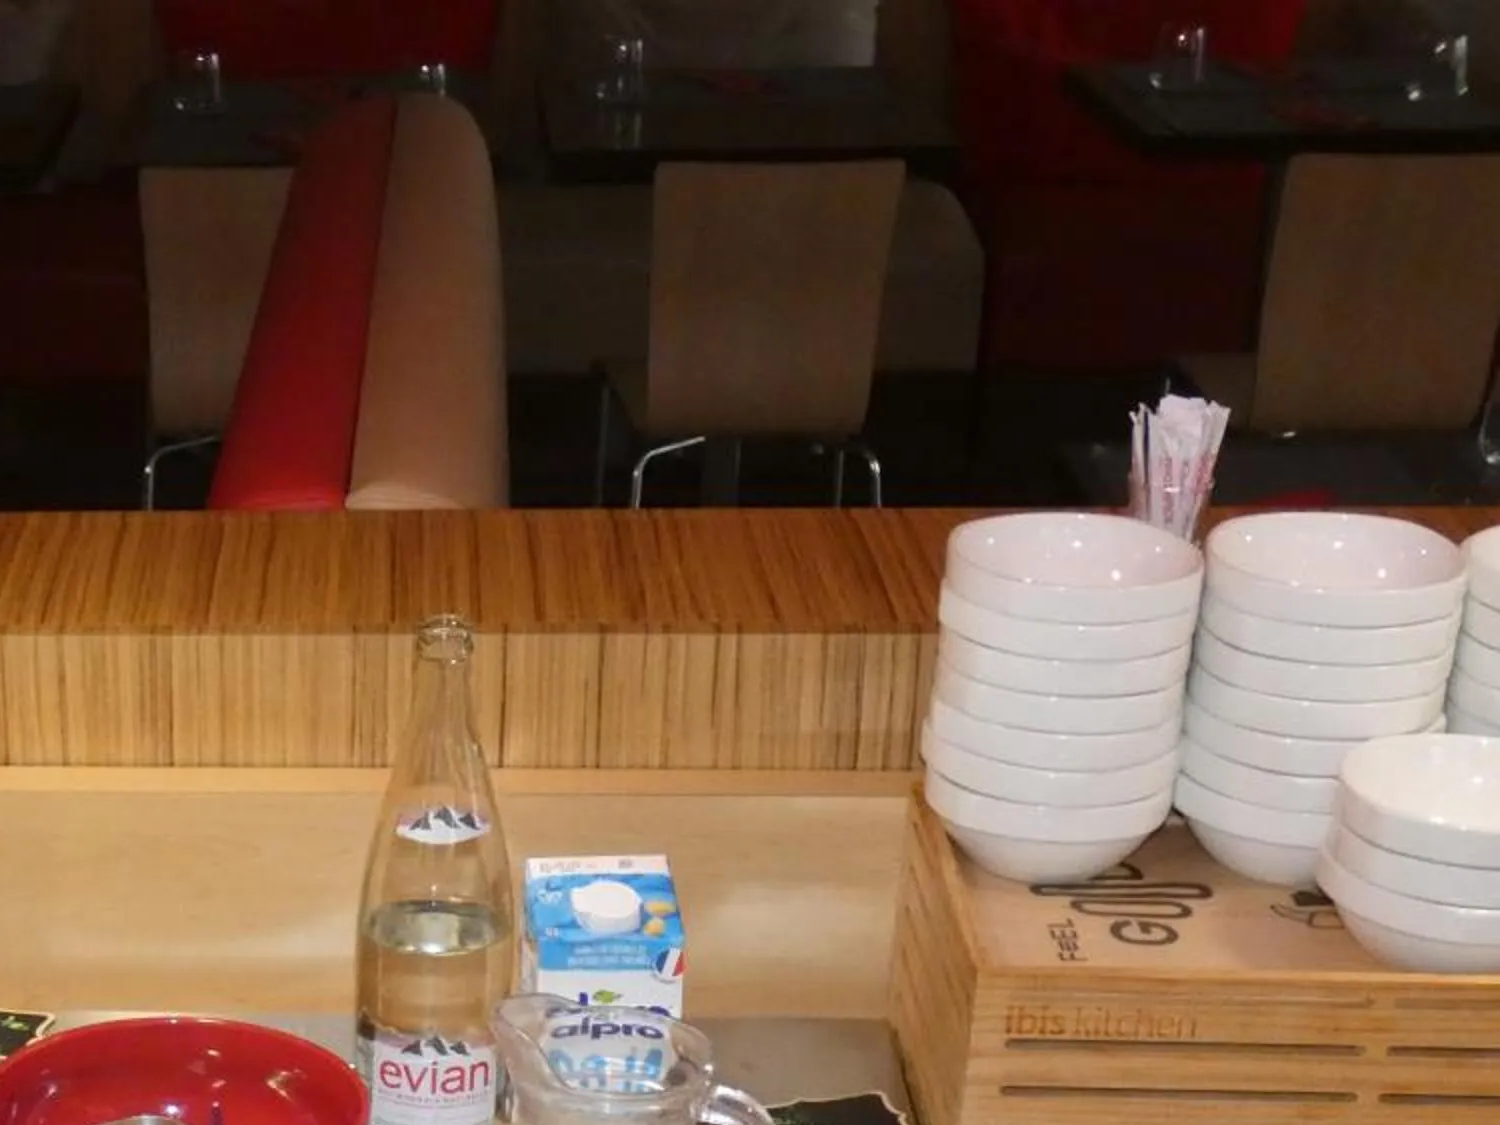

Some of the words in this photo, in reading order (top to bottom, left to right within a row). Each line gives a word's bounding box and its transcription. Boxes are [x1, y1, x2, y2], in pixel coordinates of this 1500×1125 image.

[1047, 917, 1089, 962] FEEL
[551, 1016, 665, 1040] alpro
[1004, 1003, 1067, 1037] ibis
[1072, 1005, 1198, 1039] kitchen
[379, 1059, 490, 1095] evian
